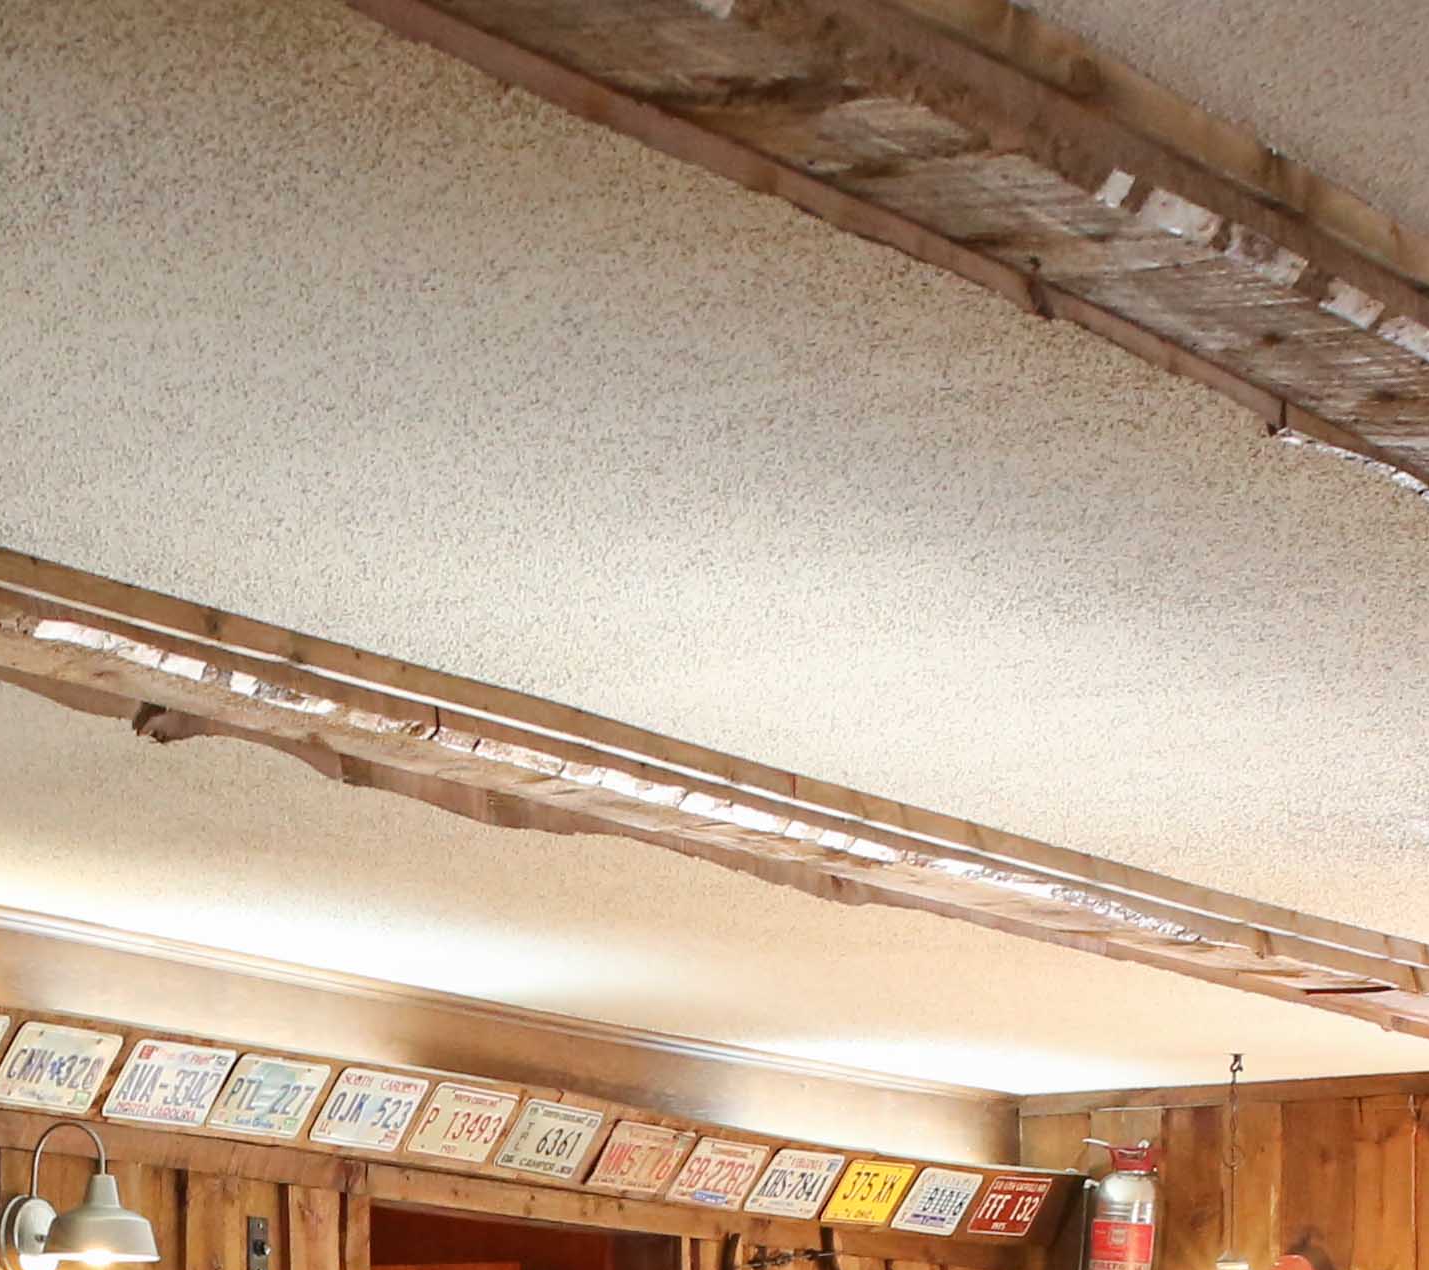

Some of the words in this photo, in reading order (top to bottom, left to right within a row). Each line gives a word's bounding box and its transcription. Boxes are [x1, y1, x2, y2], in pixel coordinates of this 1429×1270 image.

[269, 1083, 315, 1117] 227
[371, 1097, 414, 1129] 523
[419, 1107, 441, 1135] P
[443, 1111, 503, 1145] 13493
[536, 1126, 583, 1160] 6361
[843, 1171, 879, 1201] 375
[978, 1193, 1012, 1220] FFF
[1009, 1195, 1040, 1222] 132
